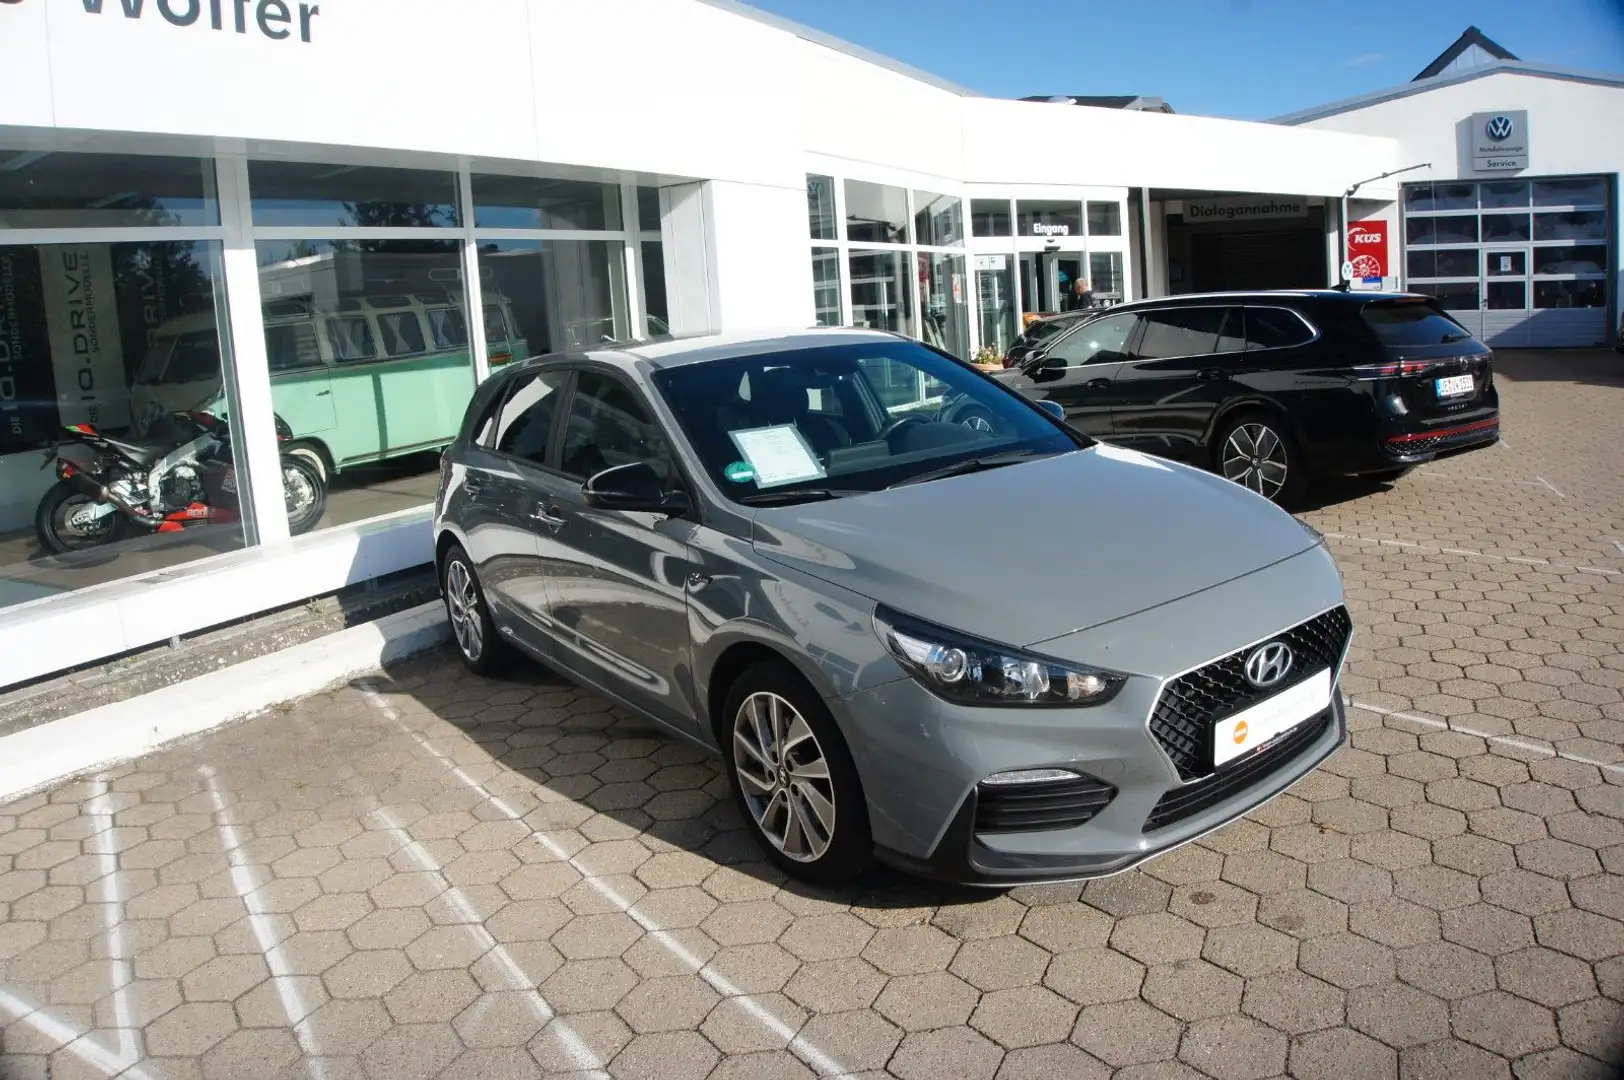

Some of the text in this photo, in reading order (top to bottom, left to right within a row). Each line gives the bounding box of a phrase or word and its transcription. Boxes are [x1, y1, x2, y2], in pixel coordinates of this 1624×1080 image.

[1486, 159, 1517, 168] Service
[1189, 200, 1301, 219] Dialogannahme
[1033, 222, 1069, 236] Eingang
[63, 251, 99, 423] DIE IQ.DRIVE
[10, 414, 22, 435] DIE
